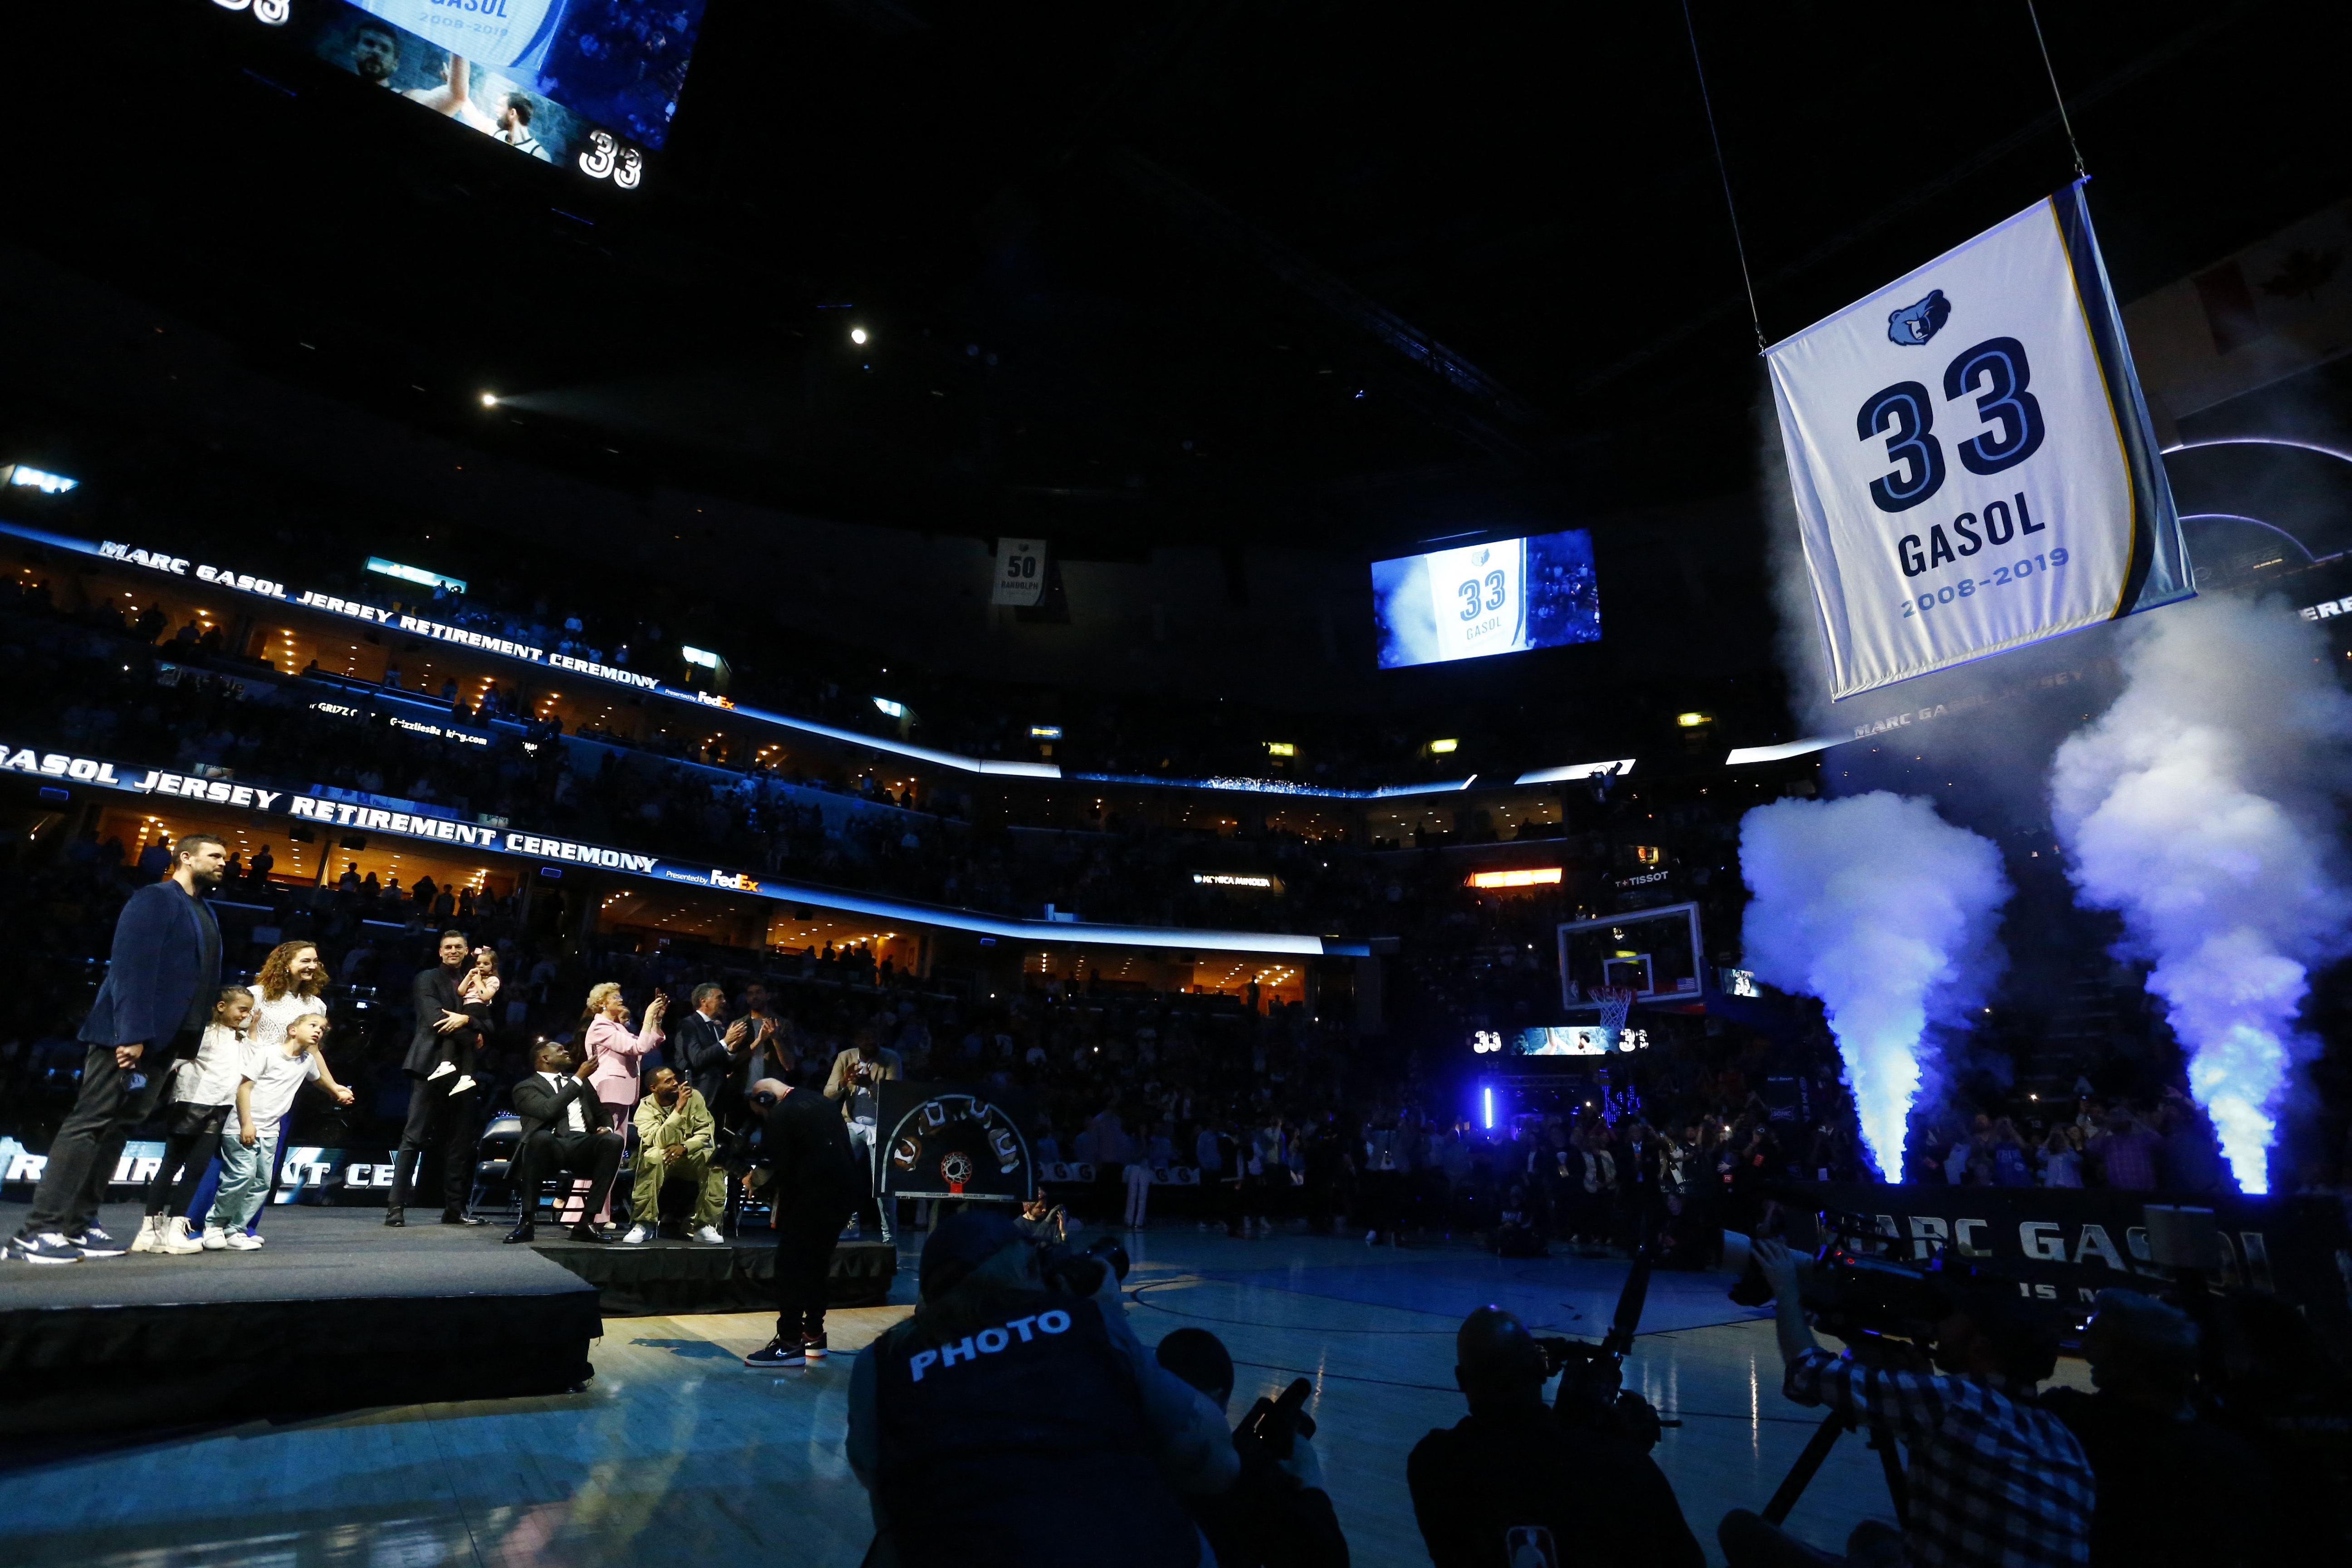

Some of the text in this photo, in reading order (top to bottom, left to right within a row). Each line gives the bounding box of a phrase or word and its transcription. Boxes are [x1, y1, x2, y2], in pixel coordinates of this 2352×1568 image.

[578, 128, 643, 190] 33
[1856, 337, 2045, 513] 33
[1898, 491, 2045, 578] GASOL
[1008, 556, 1036, 578] 50
[1001, 581, 1039, 590] RANDOLPH
[1458, 569, 1506, 621] 33
[1901, 547, 2070, 618] 2008-2019
[99, 540, 190, 575] MARC
[195, 564, 288, 599] GASOL
[296, 590, 395, 623] JERSEY
[399, 614, 543, 661] RETIREMENT
[548, 652, 660, 690] CEREMONY
[665, 689, 689, 699] Presented
[697, 691, 735, 710] FedEx
[1467, 617, 1502, 640] GASOL
[390, 718, 487, 745] GizzliesBakig.com
[1854, 713, 1911, 738] MARC
[133, 769, 282, 811] JERSEY
[289, 795, 496, 848] RETIREMENT
[505, 832, 659, 875] CEREMONY
[666, 871, 699, 882] Presented
[710, 869, 759, 892] FedEx
[1235, 877, 1270, 887] MINOLTA
[1629, 871, 1668, 886] TISSOT
[1473, 1030, 1502, 1054] 33
[2019, 1283, 2057, 1300] IS
[909, 1309, 1072, 1382] PHOTO
